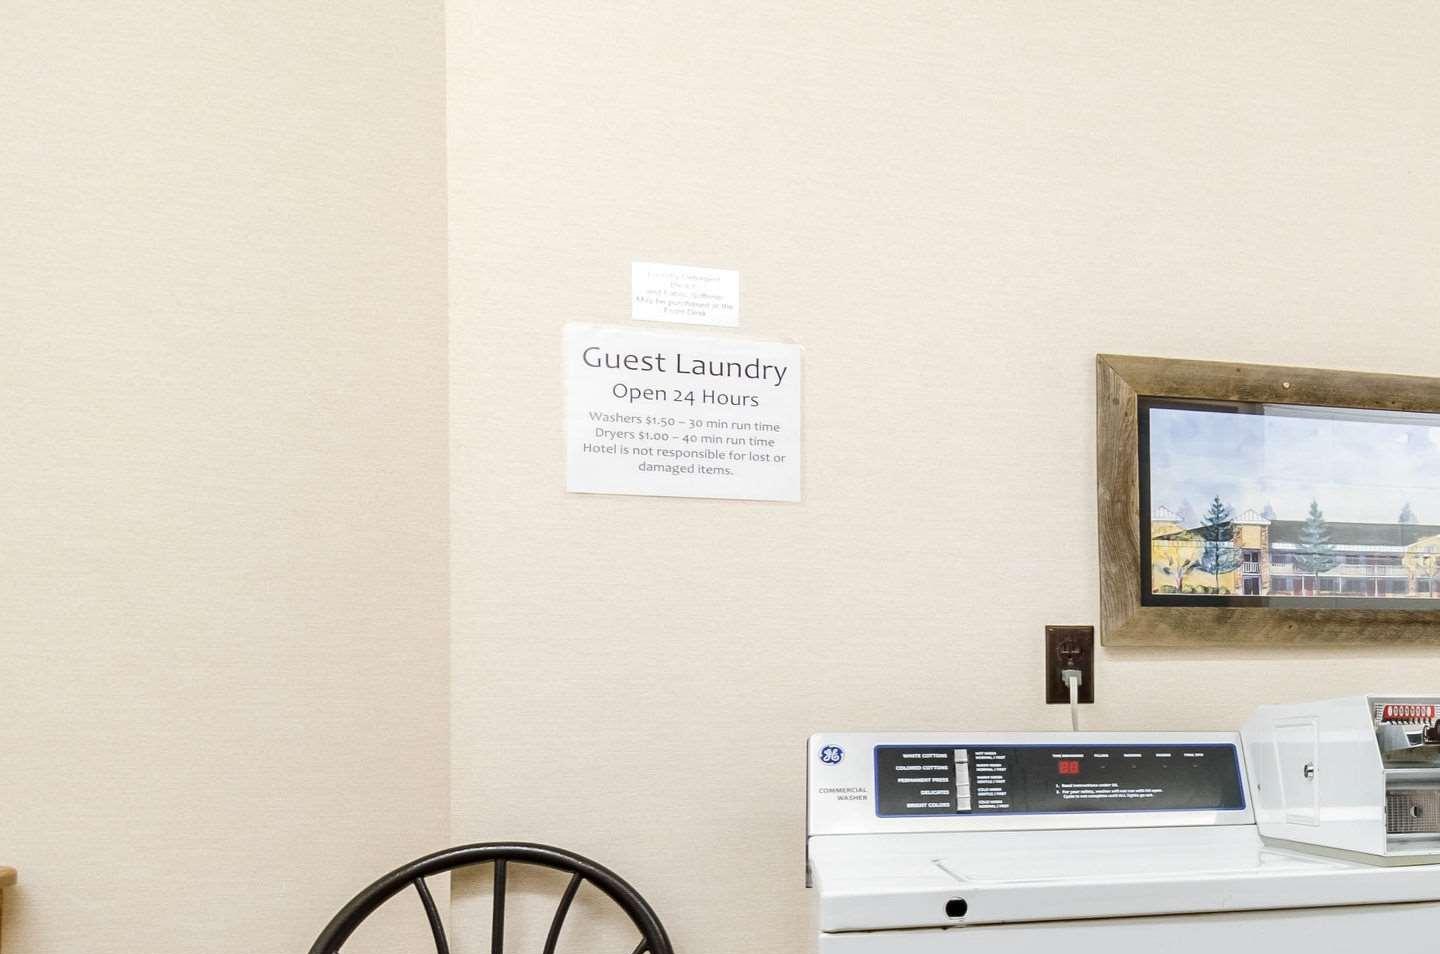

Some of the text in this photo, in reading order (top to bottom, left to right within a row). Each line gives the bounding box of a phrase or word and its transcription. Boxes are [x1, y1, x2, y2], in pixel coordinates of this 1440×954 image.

[582, 346, 788, 387] Guest Laundry
[612, 382, 760, 407] Open 24 Hours
[588, 411, 643, 425] Washers
[645, 416, 676, 428] $1.50
[688, 418, 704, 430] 30
[706, 418, 729, 430] min
[731, 421, 752, 431] run
[754, 421, 782, 433] time
[594, 427, 636, 441] Dryers
[637, 431, 670, 442] $1.00
[682, 433, 698, 445] 40
[700, 433, 723, 445] min
[726, 436, 747, 446] run
[748, 436, 776, 448] time
[582, 442, 788, 464] Hotel is not responsible for lost or
[637, 460, 735, 476] damaged items.
[818, 786, 868, 794] COMMERCIAL
